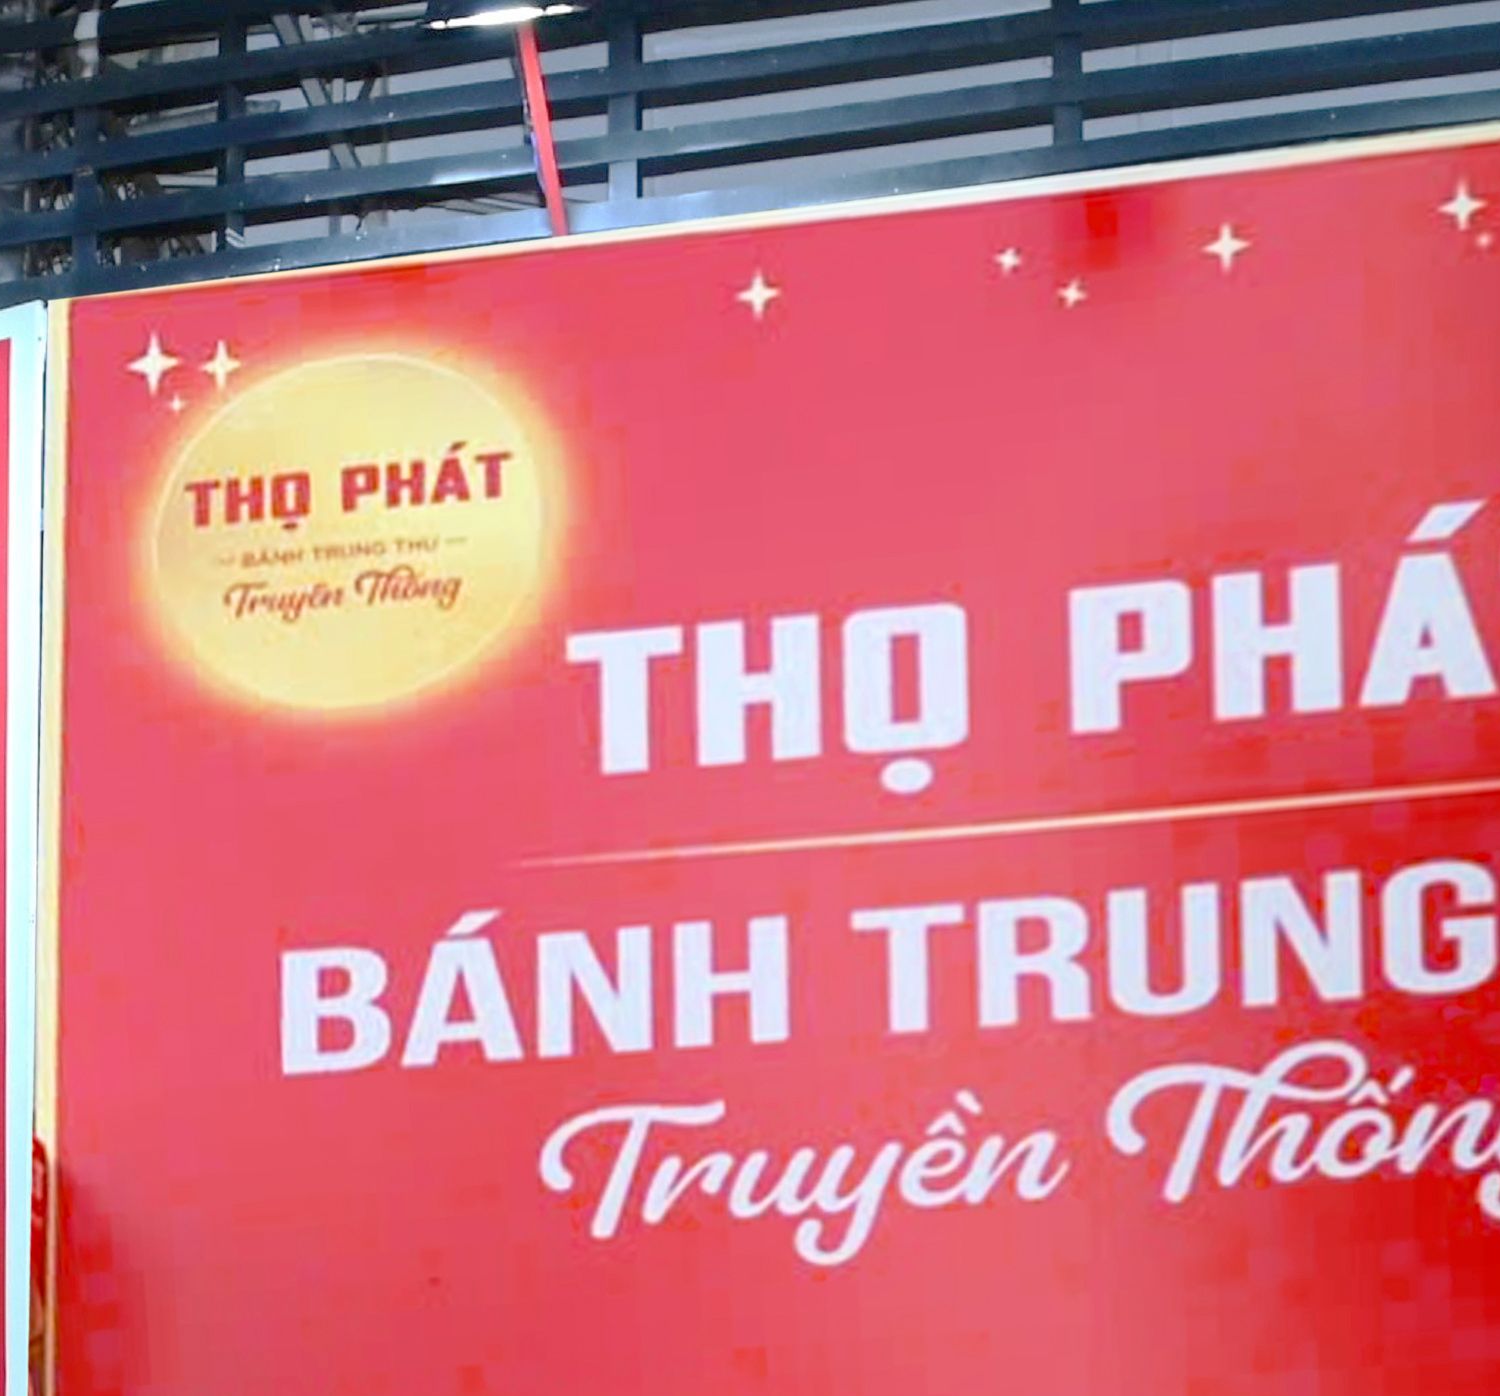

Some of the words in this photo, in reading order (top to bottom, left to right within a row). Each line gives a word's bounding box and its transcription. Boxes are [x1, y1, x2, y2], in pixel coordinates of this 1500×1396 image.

[184, 471, 311, 531] THỌ
[341, 440, 514, 512] PHÁT
[222, 580, 344, 624] Truyền
[353, 565, 462, 610] Thống
[566, 600, 973, 795] THỌ
[277, 907, 792, 1079] BÁNH
[538, 1085, 1074, 1268] Truyền
